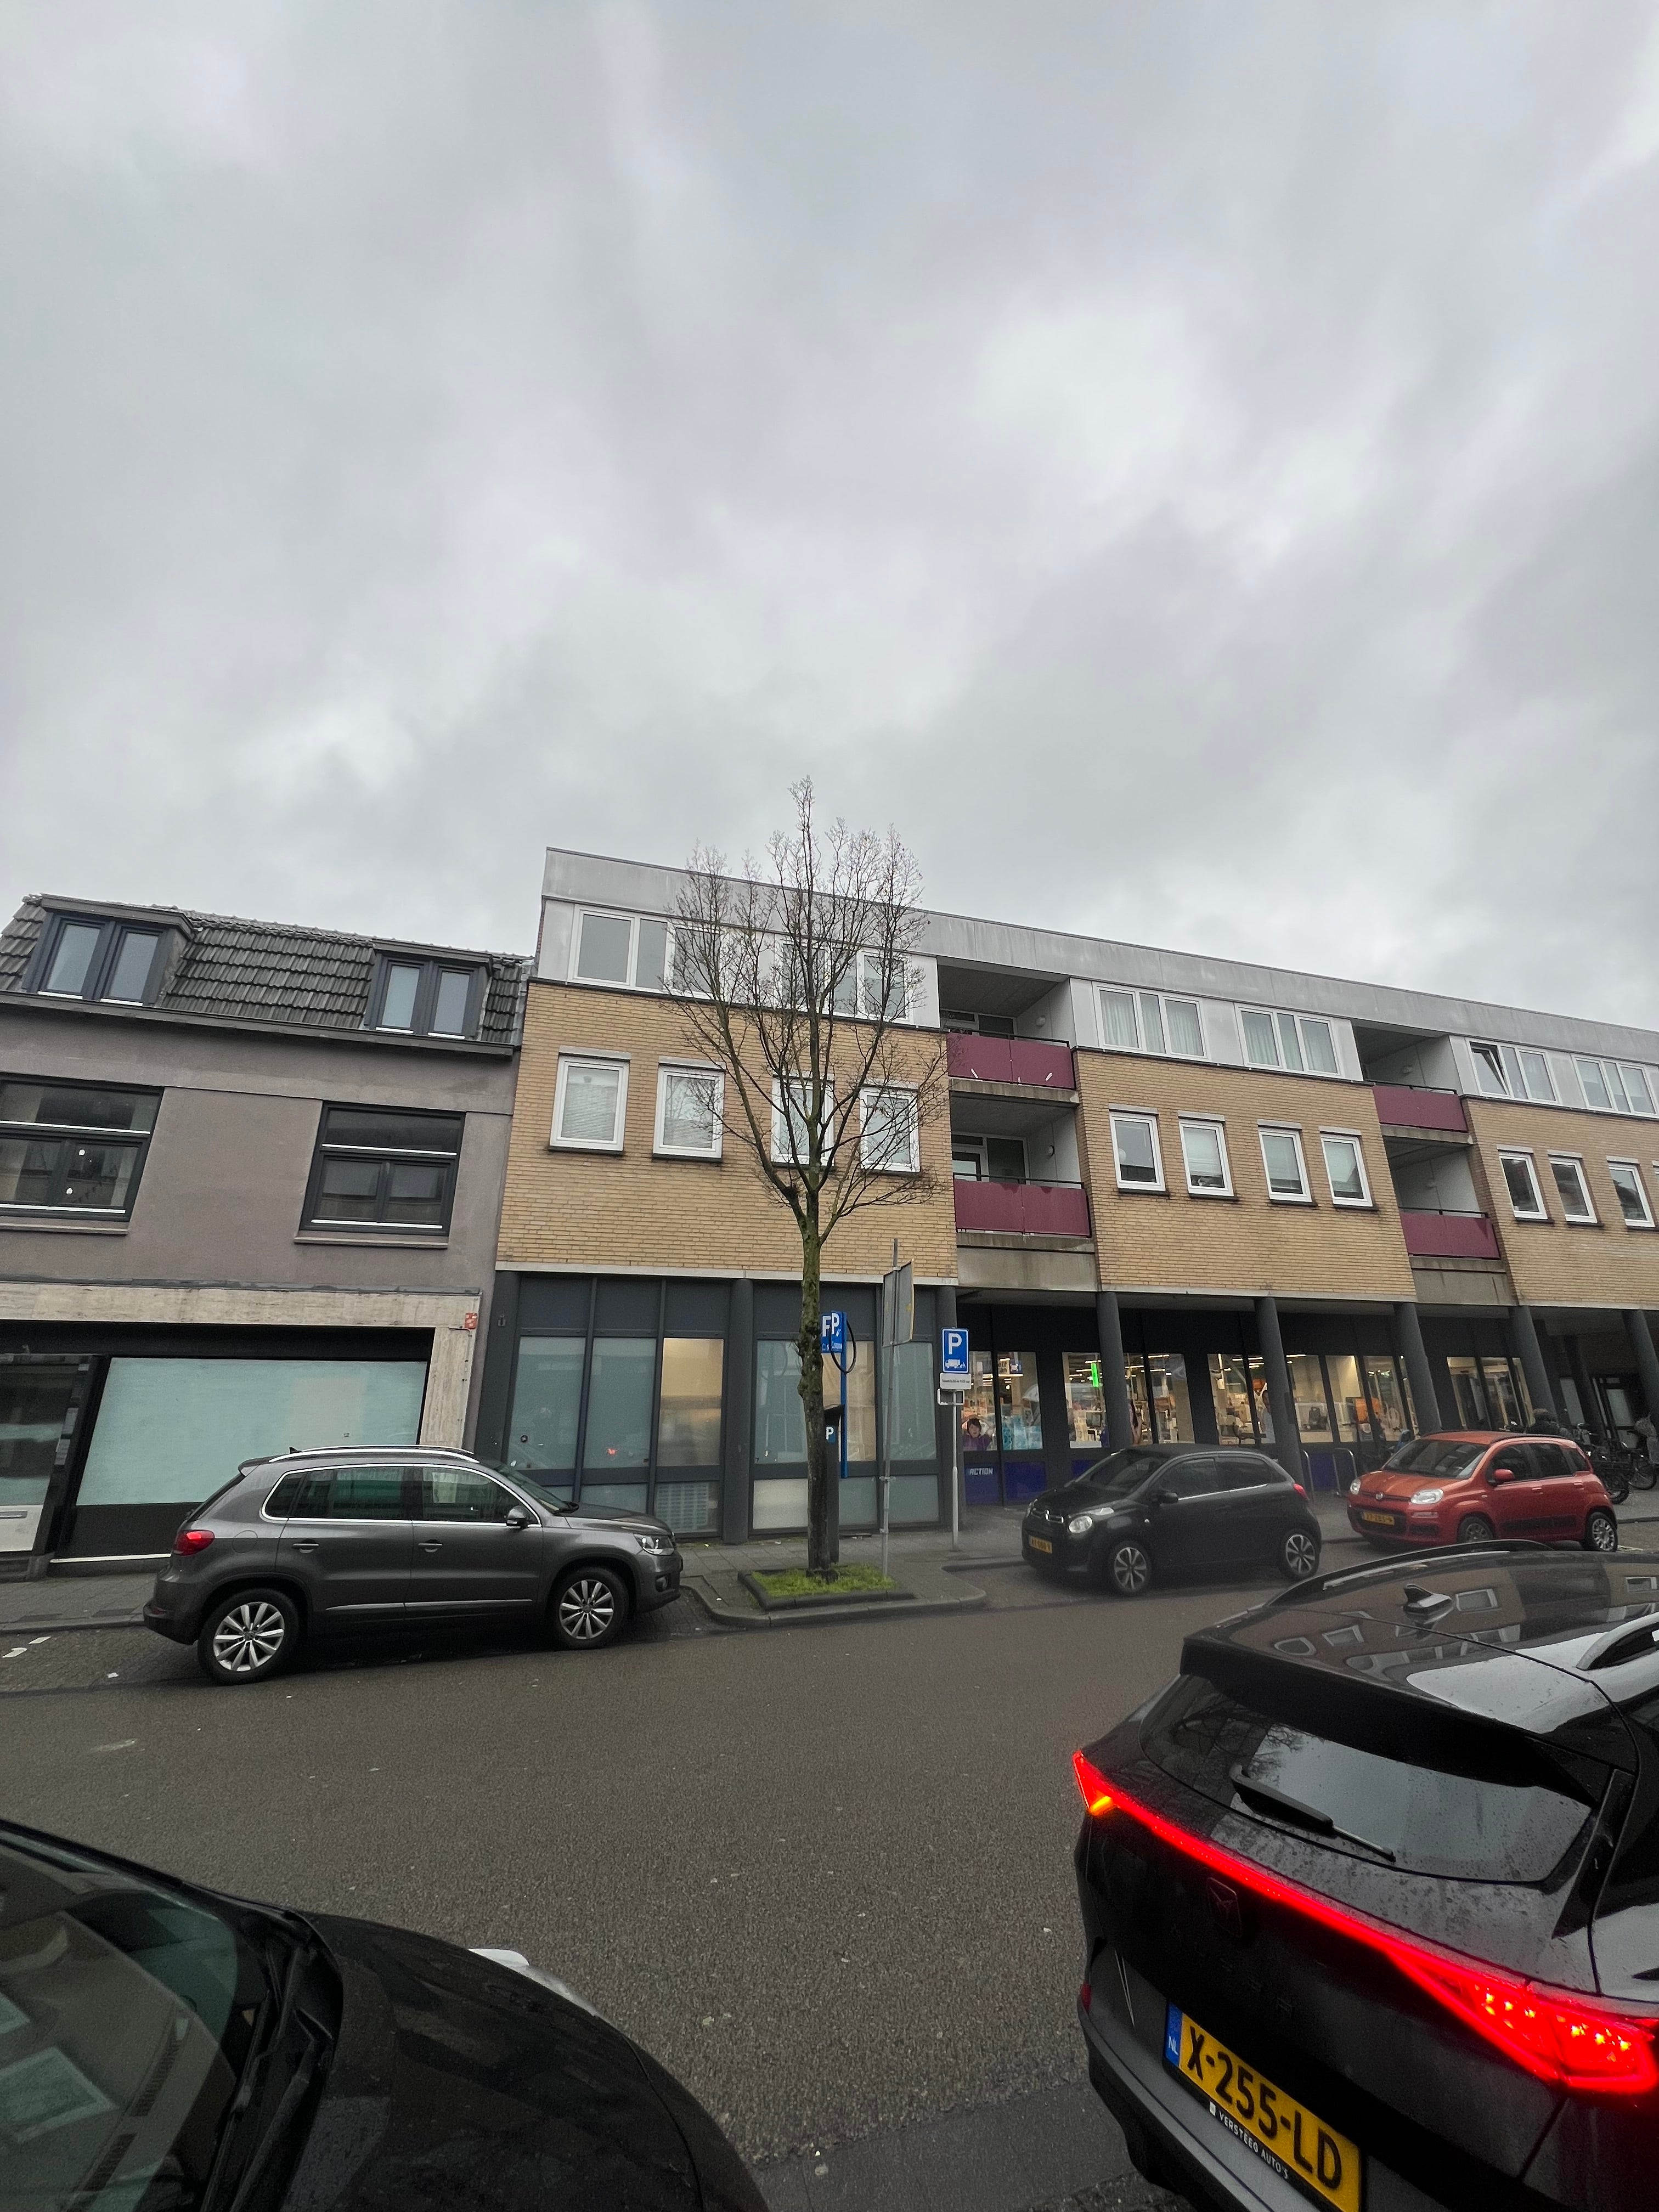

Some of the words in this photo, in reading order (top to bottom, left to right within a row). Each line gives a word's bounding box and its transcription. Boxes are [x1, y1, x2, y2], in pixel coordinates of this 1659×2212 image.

[832, 1312, 840, 1334] P
[948, 1333, 962, 1355] P
[826, 1426, 834, 1440] P
[969, 1467, 994, 1476] ACTION
[1167, 2035, 1178, 2056] NL
[1187, 2025, 1342, 2190] X-255-LD
[1261, 2148, 1289, 2180] AUTO'S
